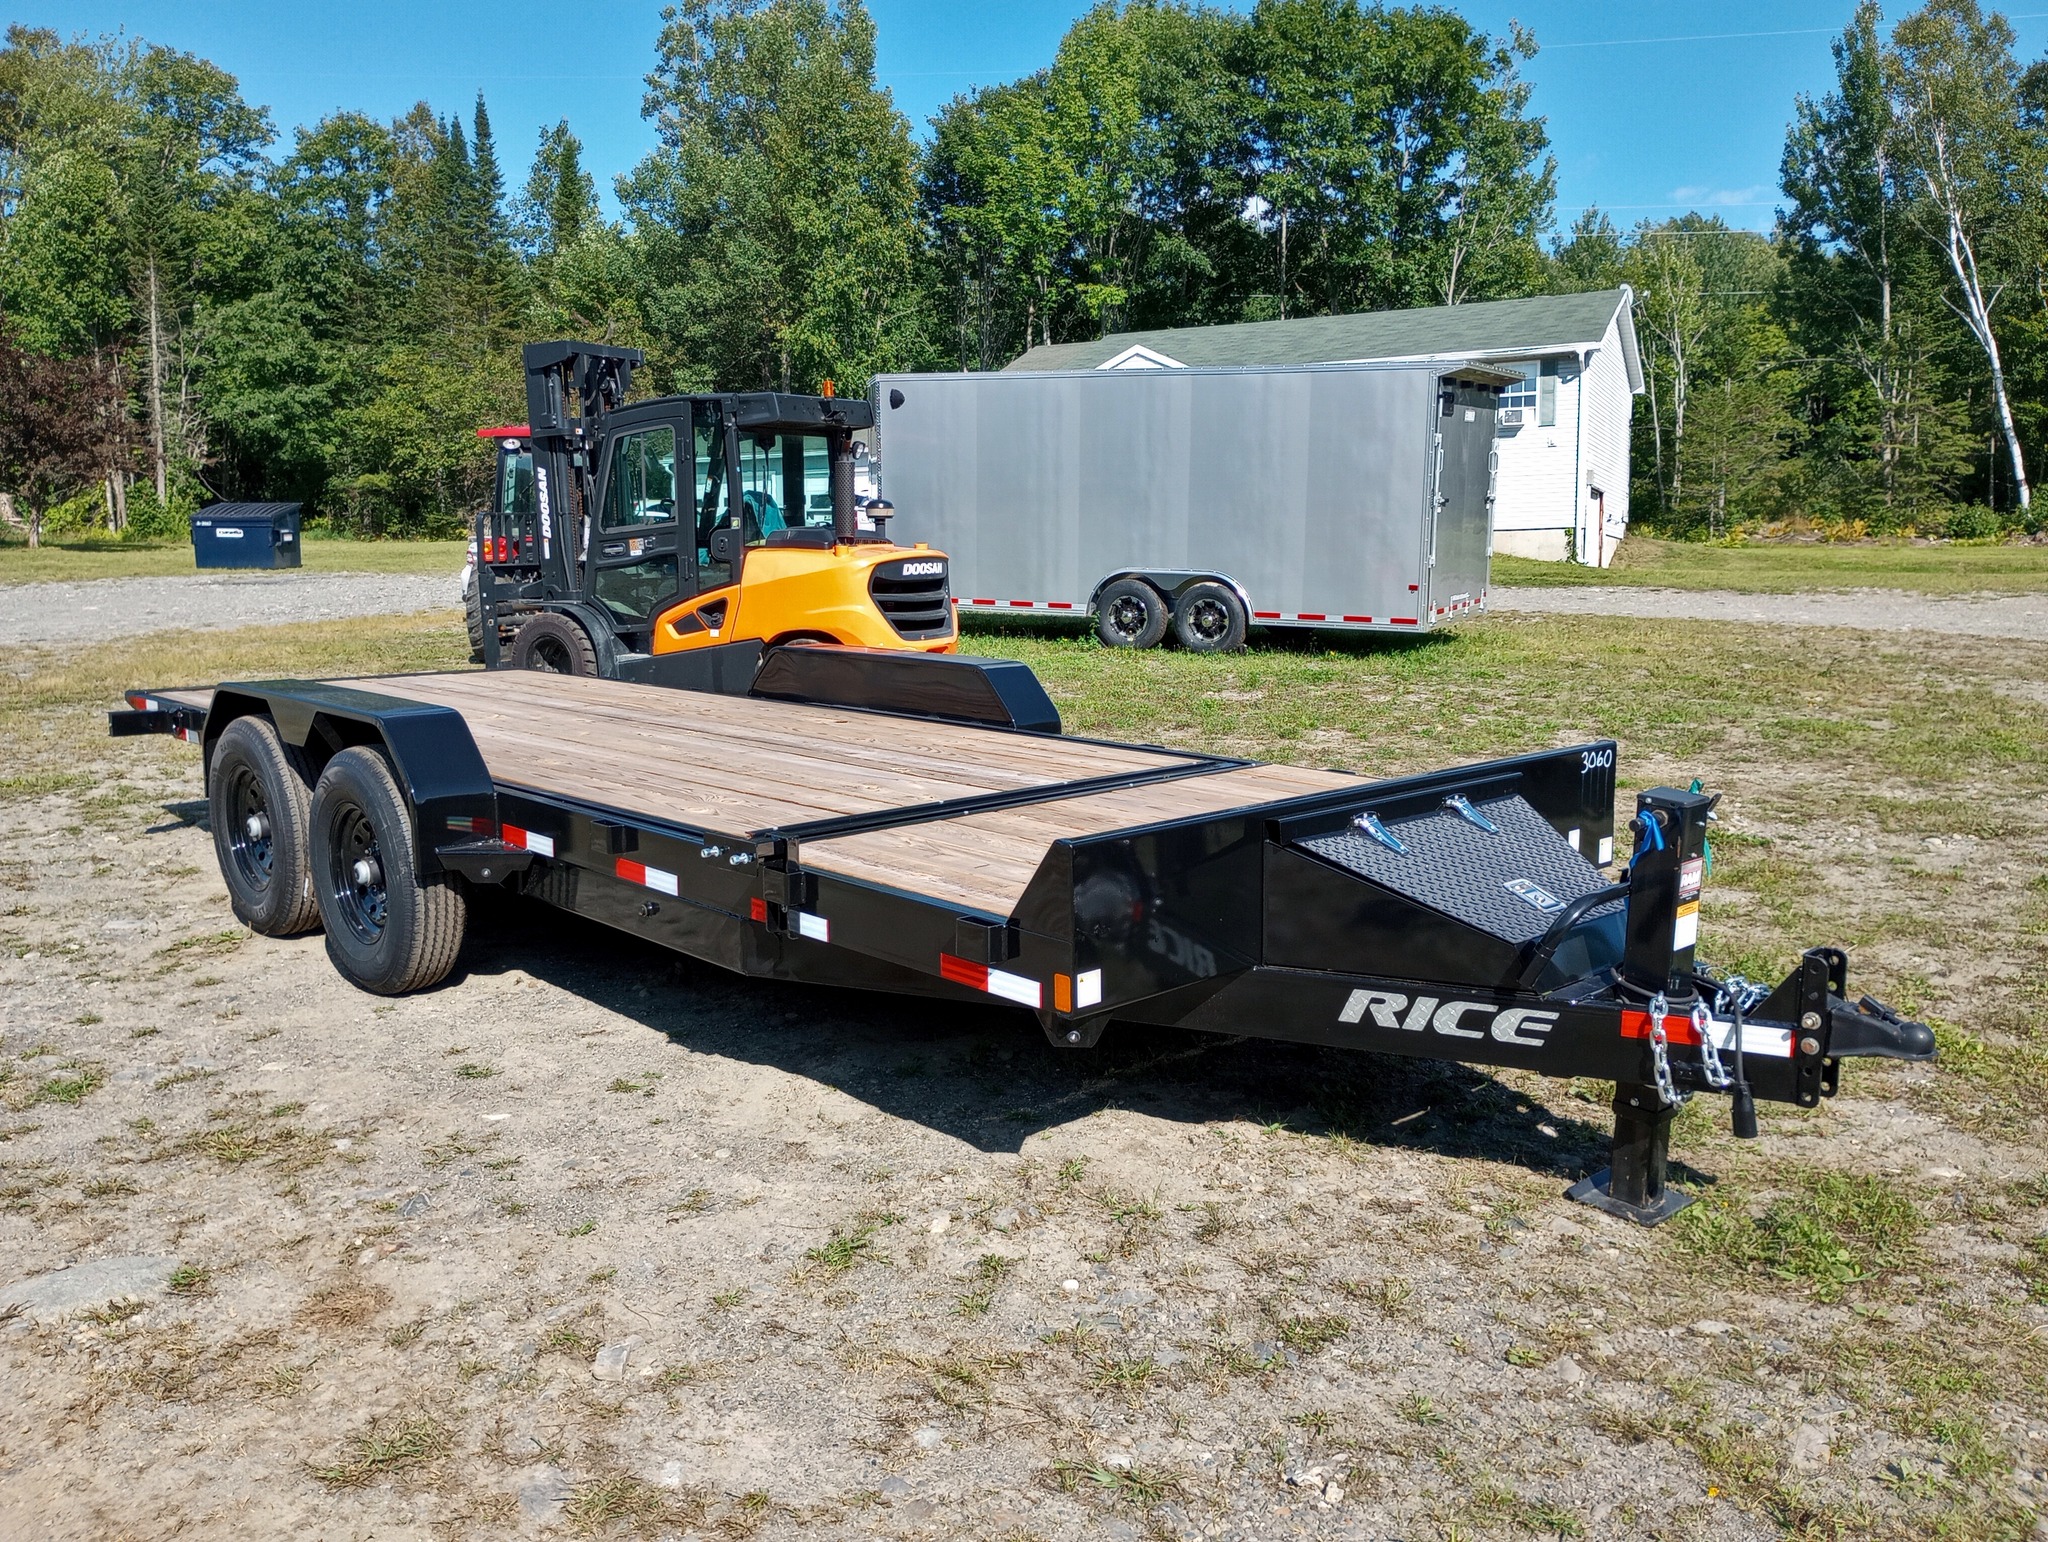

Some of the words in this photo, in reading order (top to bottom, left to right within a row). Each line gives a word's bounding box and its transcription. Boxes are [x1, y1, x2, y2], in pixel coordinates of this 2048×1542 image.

[538, 467, 552, 538] DOOSAN
[903, 562, 943, 576] DOOSAN
[1581, 749, 1613, 774] 3060
[1337, 988, 1561, 1047] RICE
